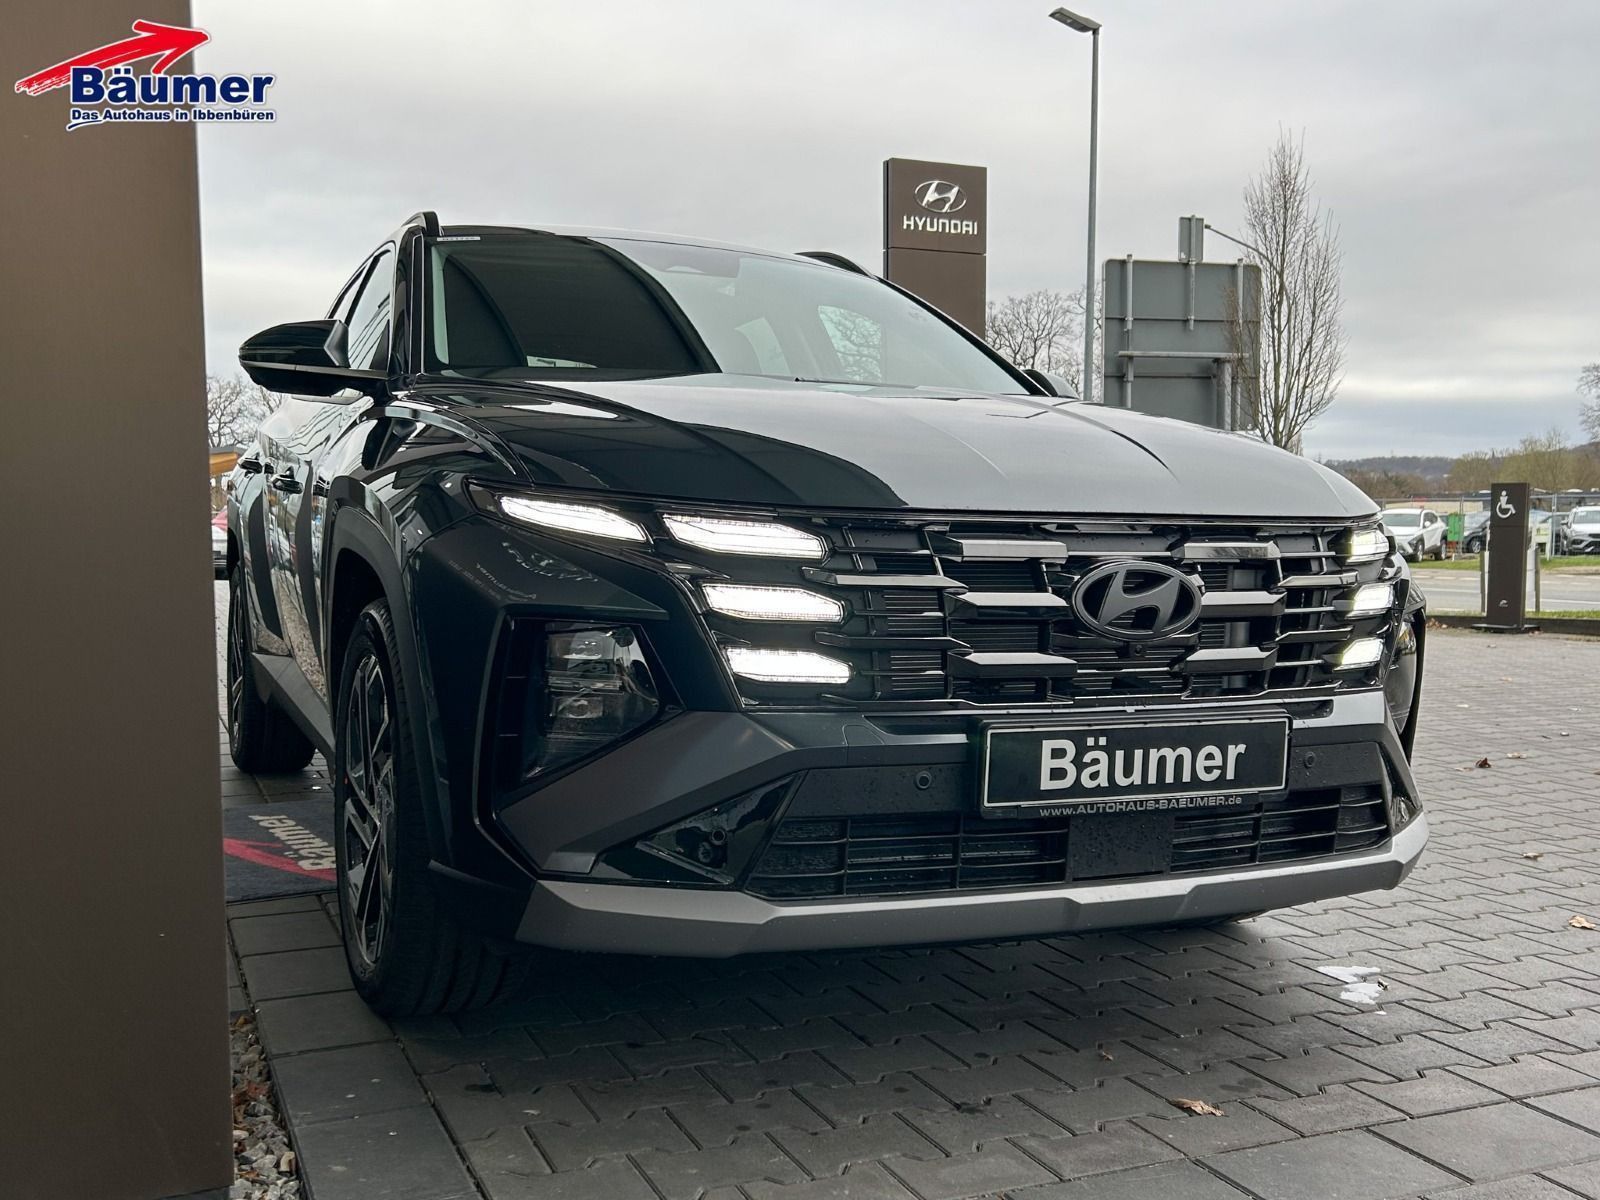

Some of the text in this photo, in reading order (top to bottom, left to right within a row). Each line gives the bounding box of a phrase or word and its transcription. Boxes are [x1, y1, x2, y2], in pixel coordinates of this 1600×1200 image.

[903, 215, 978, 235] HYUNDAI
[1040, 736, 1246, 790] Bäumer
[1039, 796, 1242, 817] www.AUTOHAUS-BAEUMER.de
